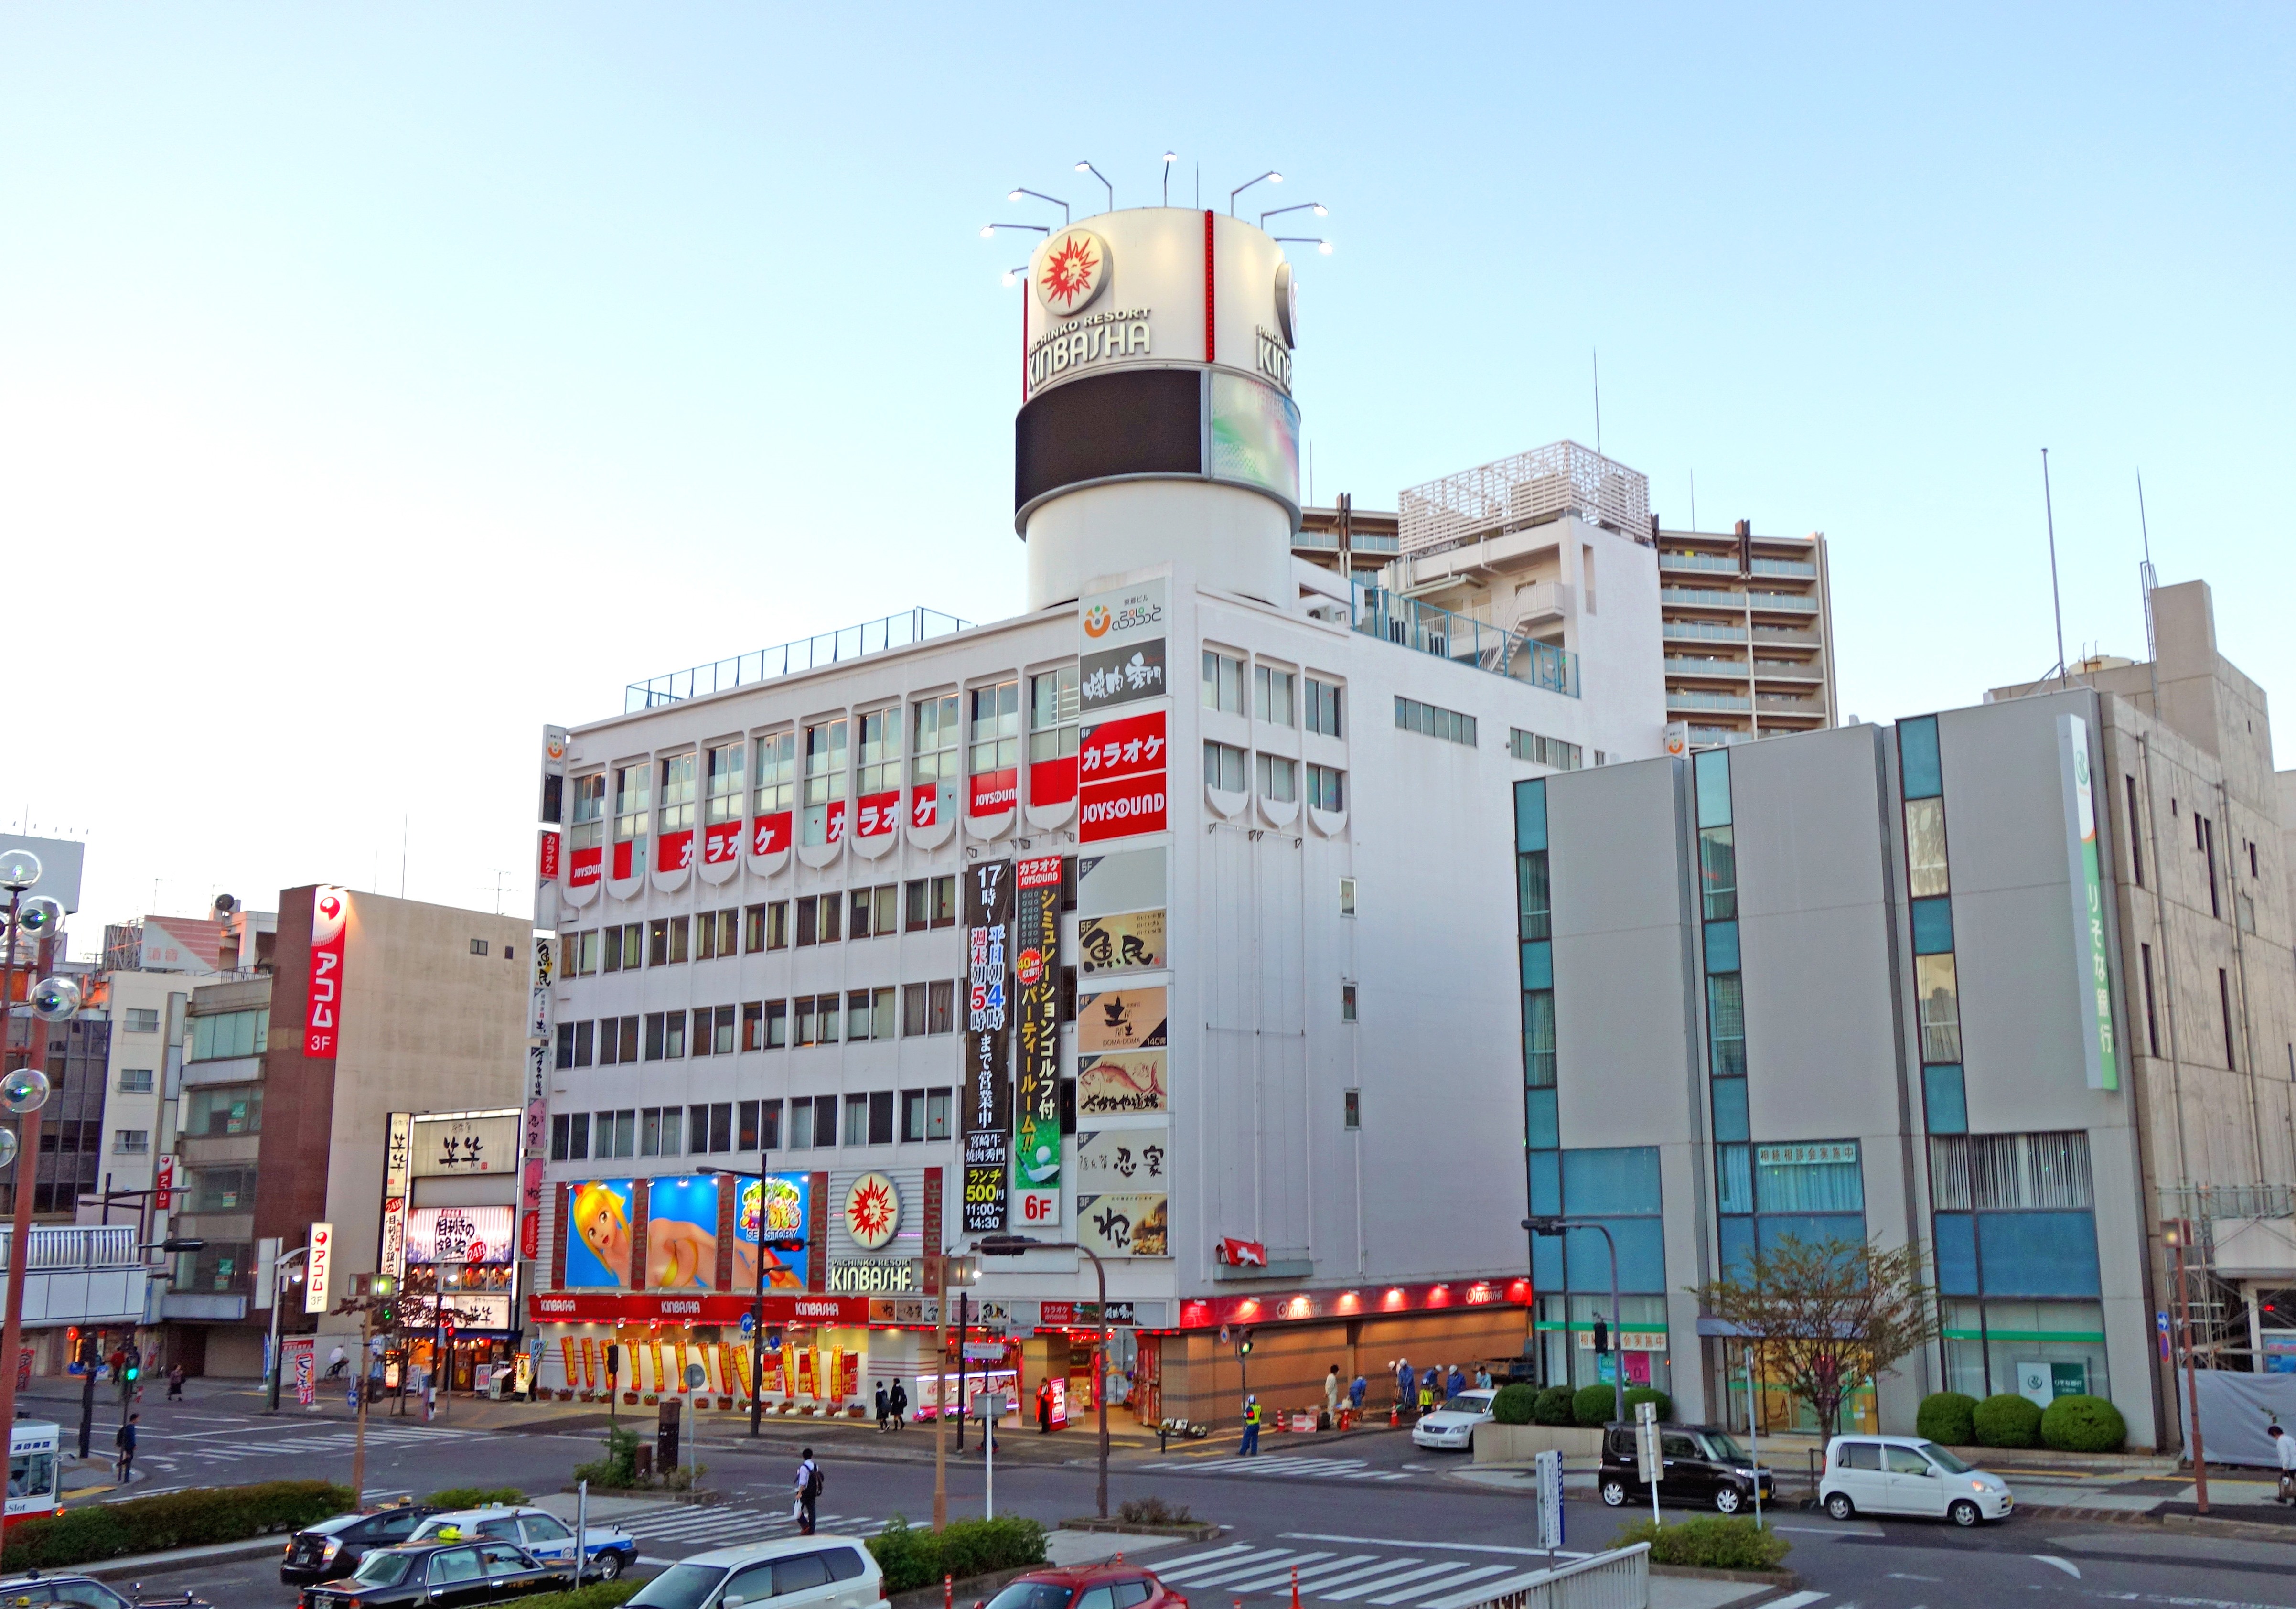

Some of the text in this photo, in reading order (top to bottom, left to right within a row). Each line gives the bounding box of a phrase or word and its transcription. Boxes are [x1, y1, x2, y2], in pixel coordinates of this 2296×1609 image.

[1084, 306, 1151, 328] RESORT
[1029, 321, 1151, 392] KINBASHA
[1081, 729, 1091, 738] 6F
[1082, 735, 1164, 772] カラオケ
[976, 788, 1017, 807] JOYSOUN
[1082, 793, 1165, 824] JOYSOUND
[828, 796, 936, 840] カラオケ
[546, 835, 556, 873] カラオケ
[679, 826, 775, 866] カラオケ
[574, 864, 602, 878] JOYSOUN
[1020, 858, 1060, 876] カラオケ
[1021, 872, 1058, 886] JOYSOUND
[1083, 928, 1154, 973] 魚民
[2088, 883, 2113, 1054] りそな銀行
[311, 951, 337, 1029] アコム
[1039, 890, 1056, 1120] シミュレーションゴルフ付
[311, 1035, 331, 1051] 3F
[977, 1033, 994, 1129] まで営業中
[970, 1133, 1001, 1148] 宮崎牛
[1079, 1133, 1089, 1144] 3F
[969, 1169, 1001, 1184] ランチ
[966, 1184, 1004, 1201] 500円
[386, 1199, 403, 1212] 24H
[1025, 1195, 1051, 1220] 6F
[1079, 1197, 1089, 1208] 3F
[969, 1216, 999, 1230] 14:30
[747, 1229, 797, 1241] SE STORY
[467, 1243, 486, 1261] 24H
[312, 1250, 325, 1291] アコム
[831, 1266, 913, 1291] KINBASHA
[311, 1296, 322, 1305] 3F
[540, 1299, 576, 1312] KINBASHA
[661, 1300, 701, 1314] KINBASHA
[795, 1302, 839, 1316] KINBASHA
[1044, 1305, 1069, 1315] カラオケ
